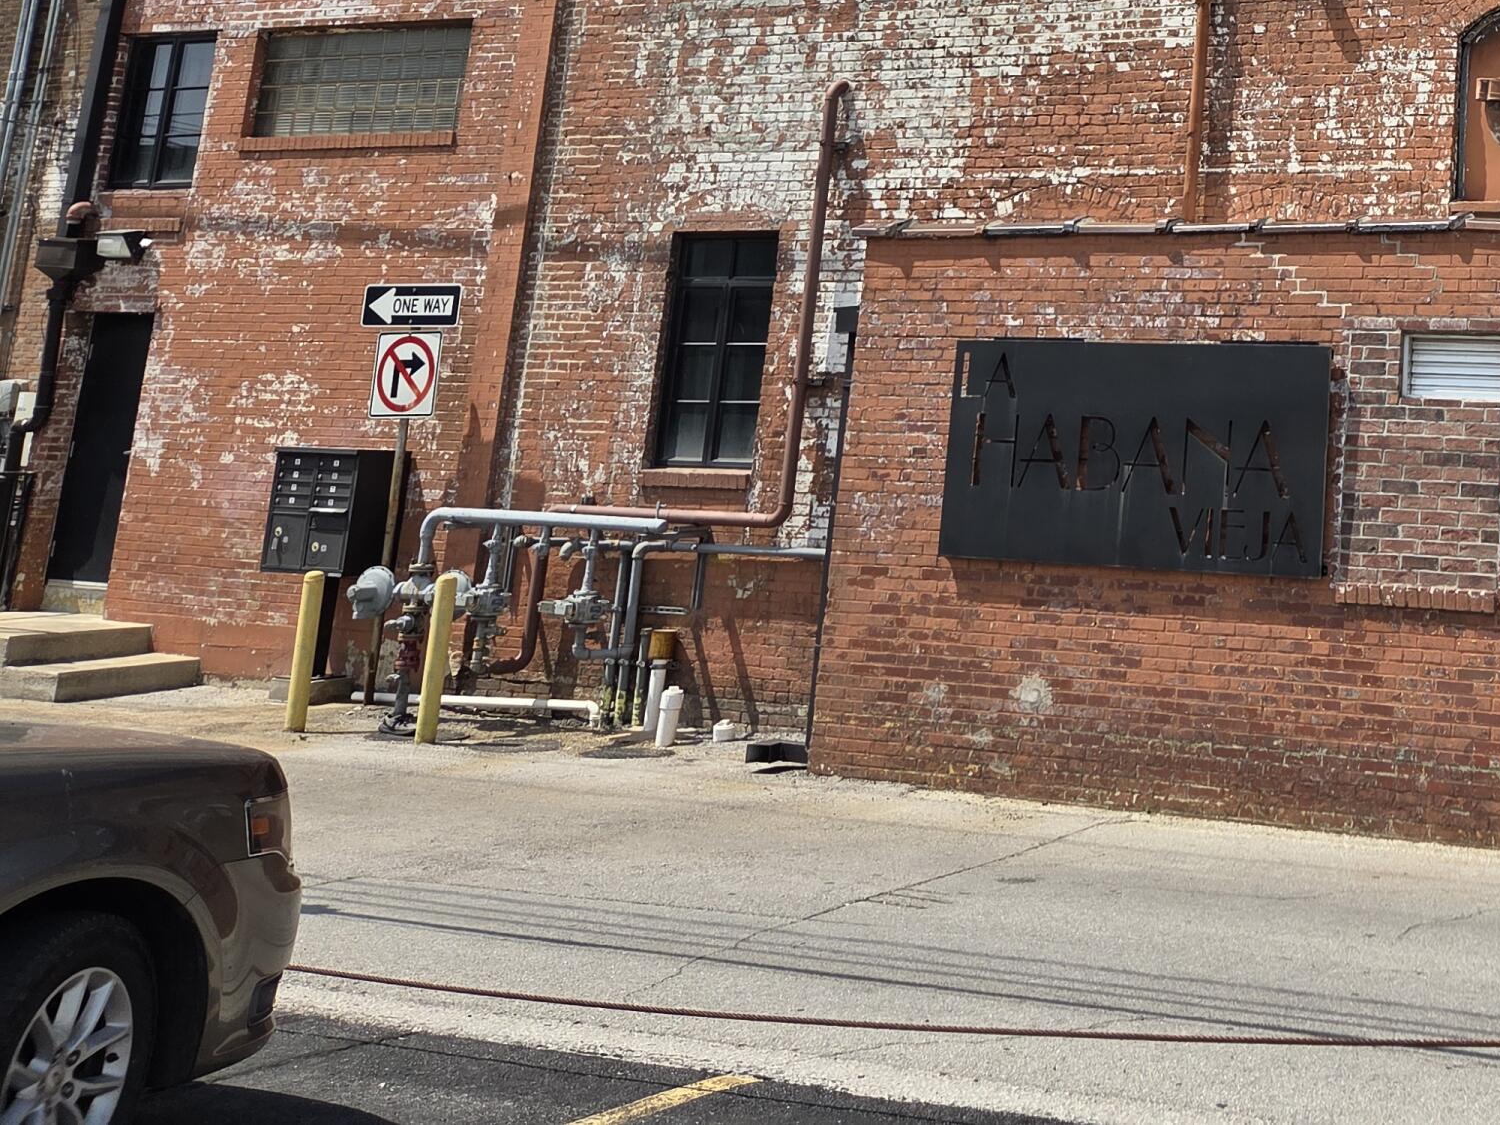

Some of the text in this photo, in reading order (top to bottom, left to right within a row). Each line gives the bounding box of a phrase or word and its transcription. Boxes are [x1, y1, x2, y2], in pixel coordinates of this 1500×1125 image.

[393, 298, 450, 314] ONE WAY
[961, 351, 1017, 399] LA
[970, 412, 1290, 499] HABANA
[1169, 506, 1308, 564] VIEJA
